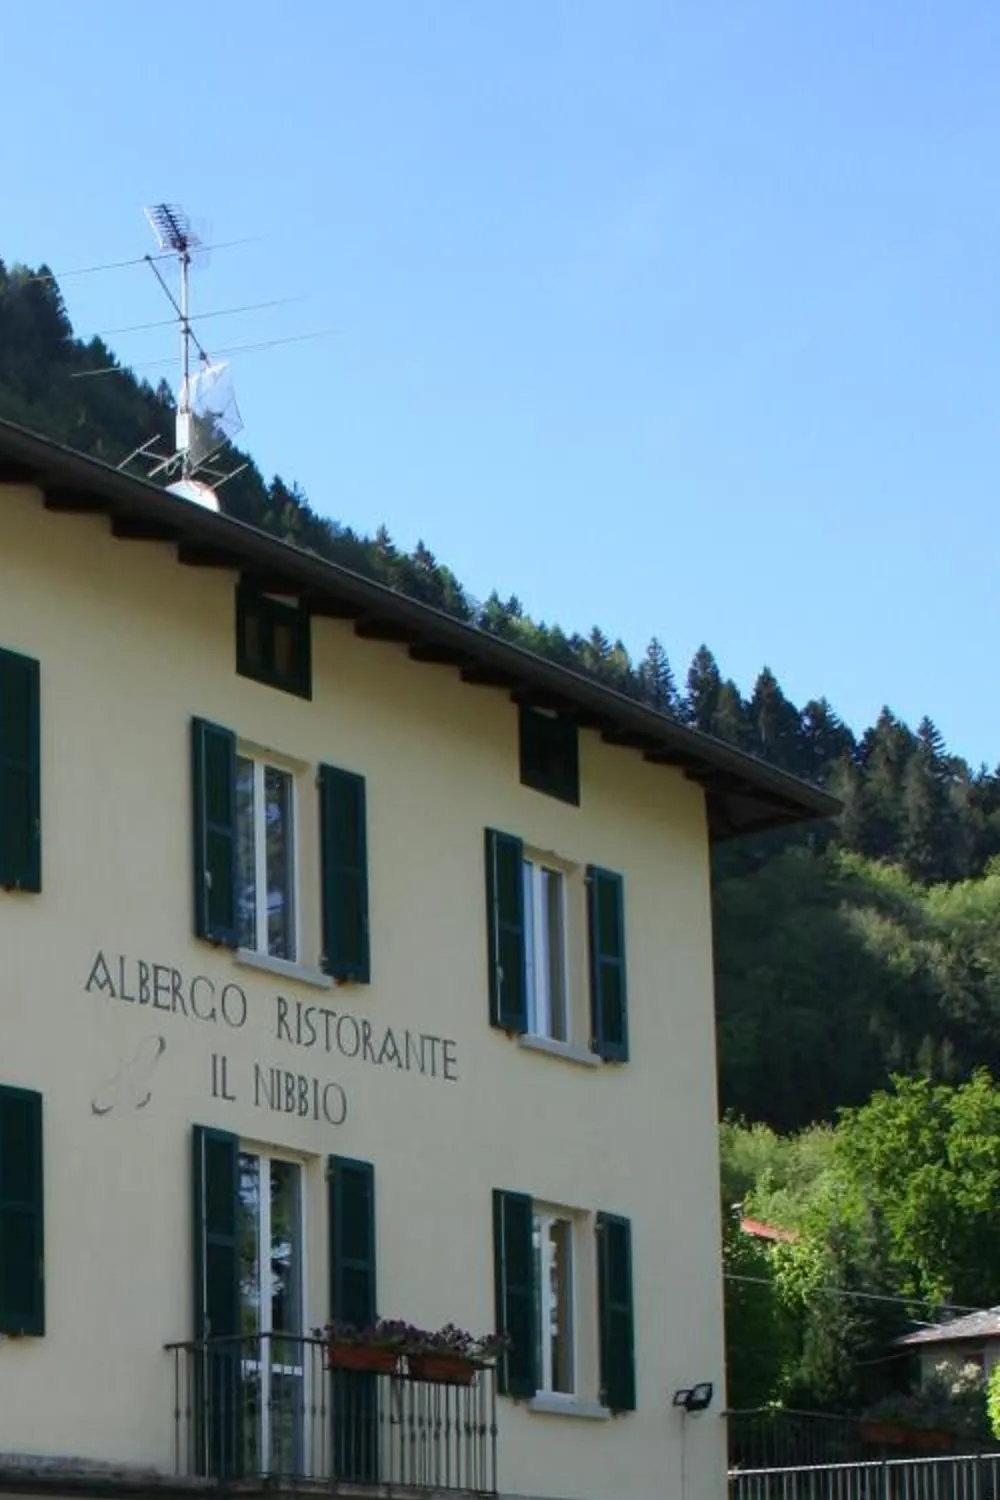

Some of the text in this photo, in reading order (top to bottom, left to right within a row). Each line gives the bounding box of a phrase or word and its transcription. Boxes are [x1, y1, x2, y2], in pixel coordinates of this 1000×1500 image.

[85, 950, 458, 1082] ALBERGO RISTORANTE
[210, 1053, 347, 1125] IL NIBBIO
